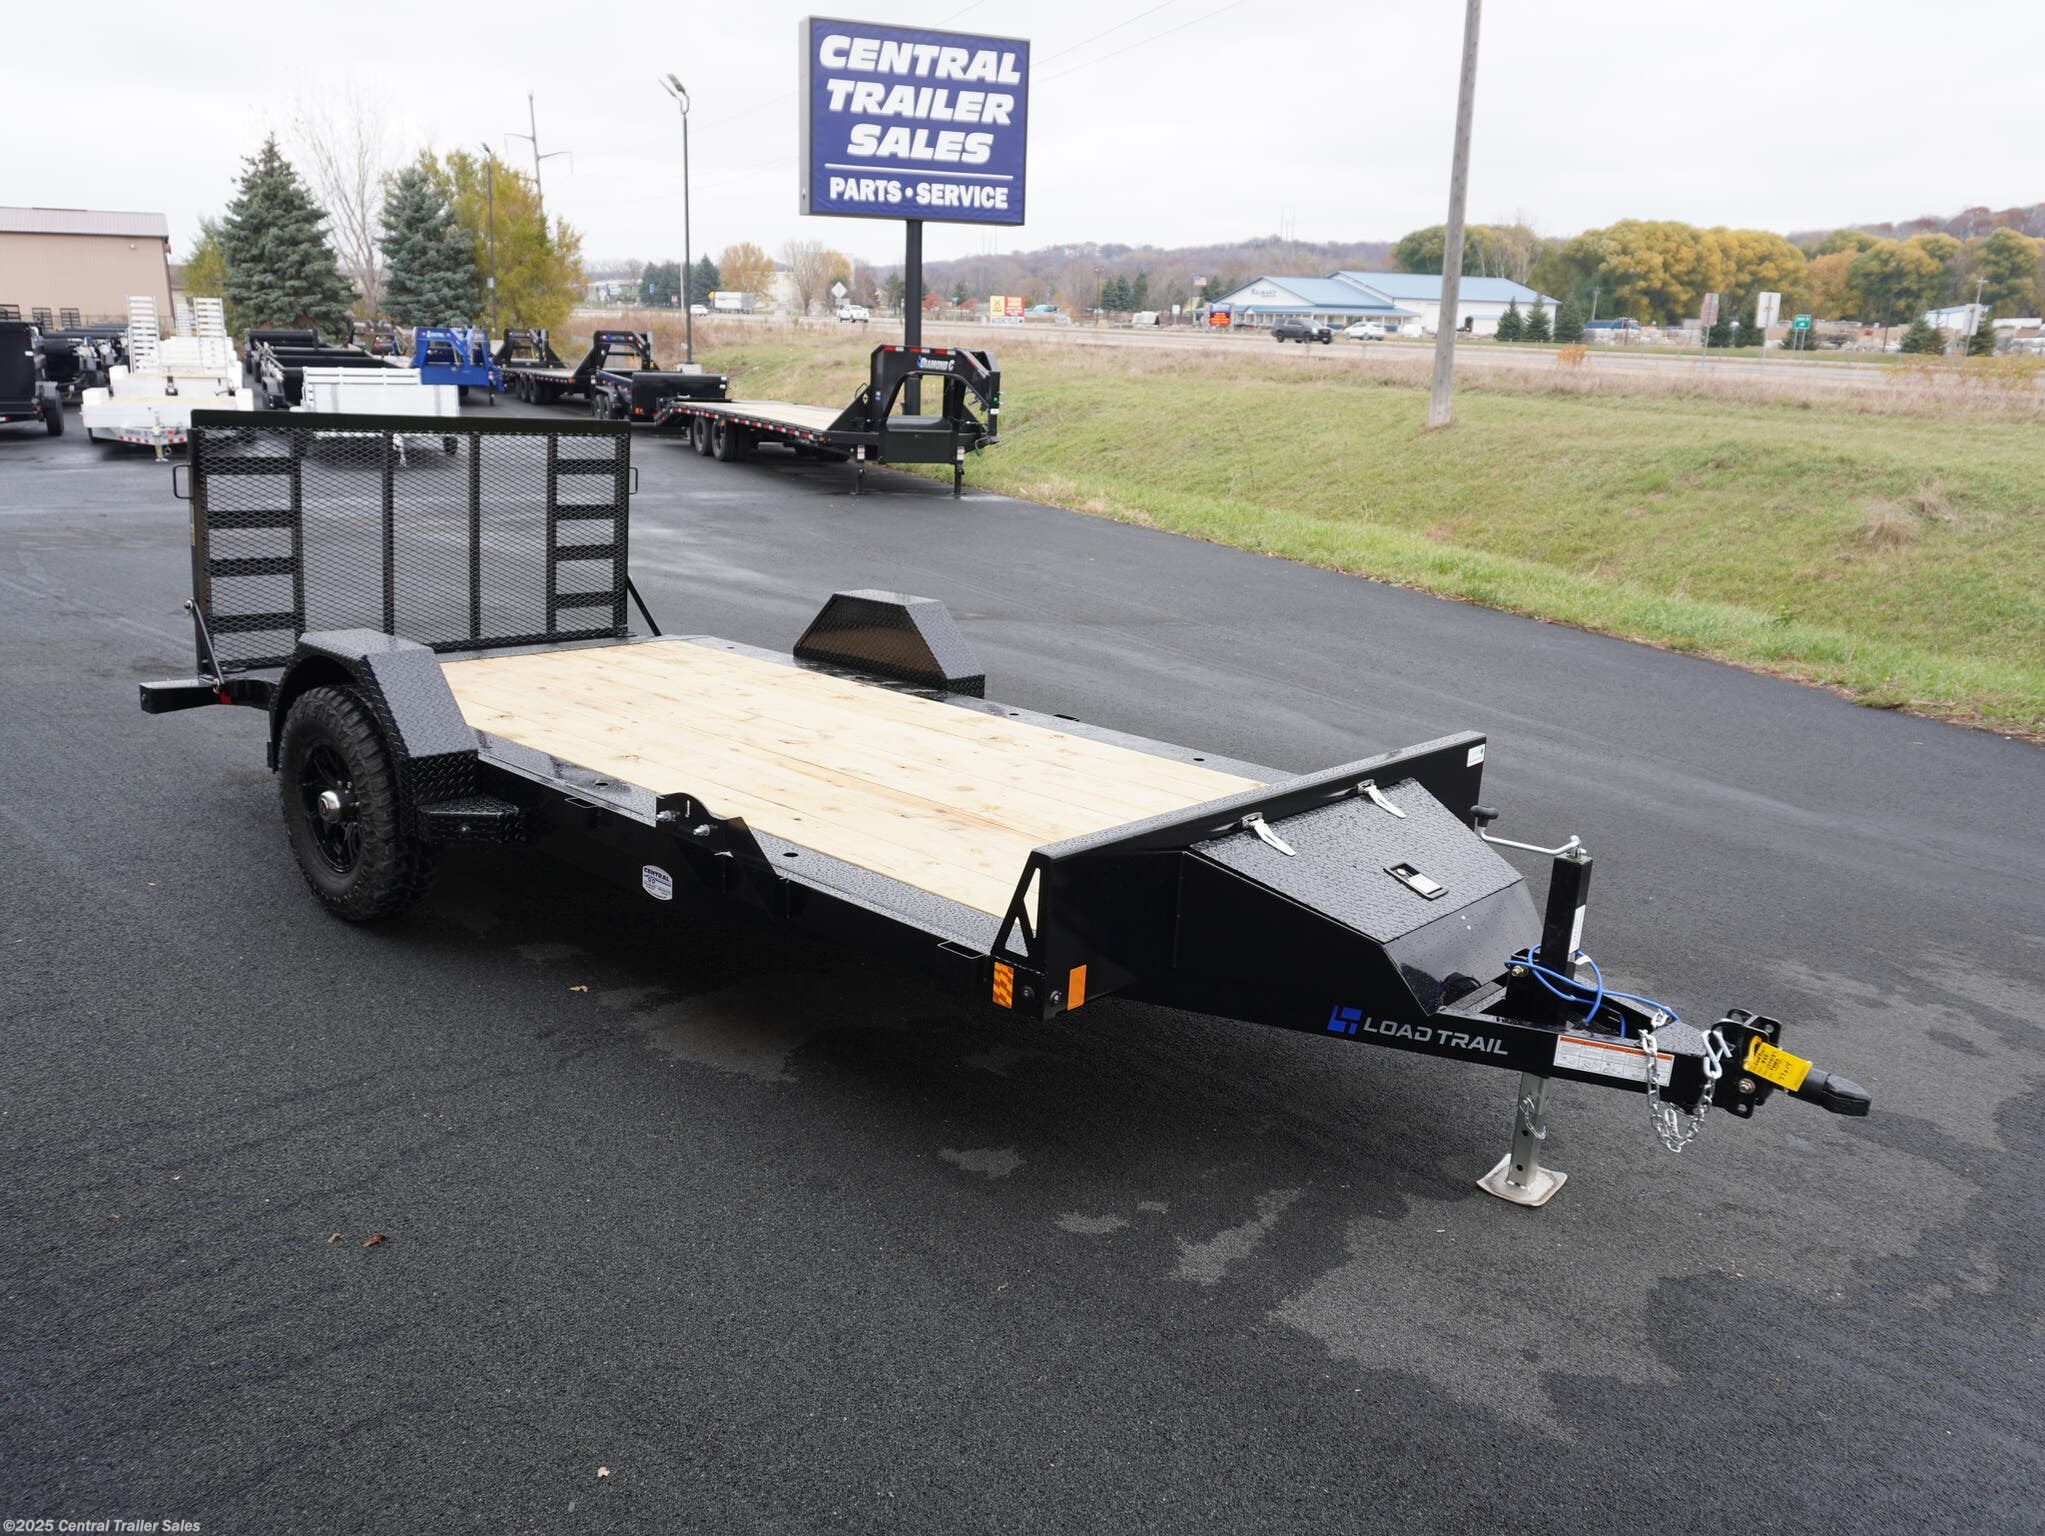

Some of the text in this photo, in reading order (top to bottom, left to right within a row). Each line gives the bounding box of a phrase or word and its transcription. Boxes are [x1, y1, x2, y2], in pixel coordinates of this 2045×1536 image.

[819, 34, 1021, 85] CENTRAL
[826, 78, 1015, 126] TRAILER
[846, 123, 994, 165] SALES
[829, 176, 1009, 209] PARTS SERVICE
[643, 867, 670, 882] CENTRAL
[1363, 1016, 1509, 1055] LOAD TRAIL
